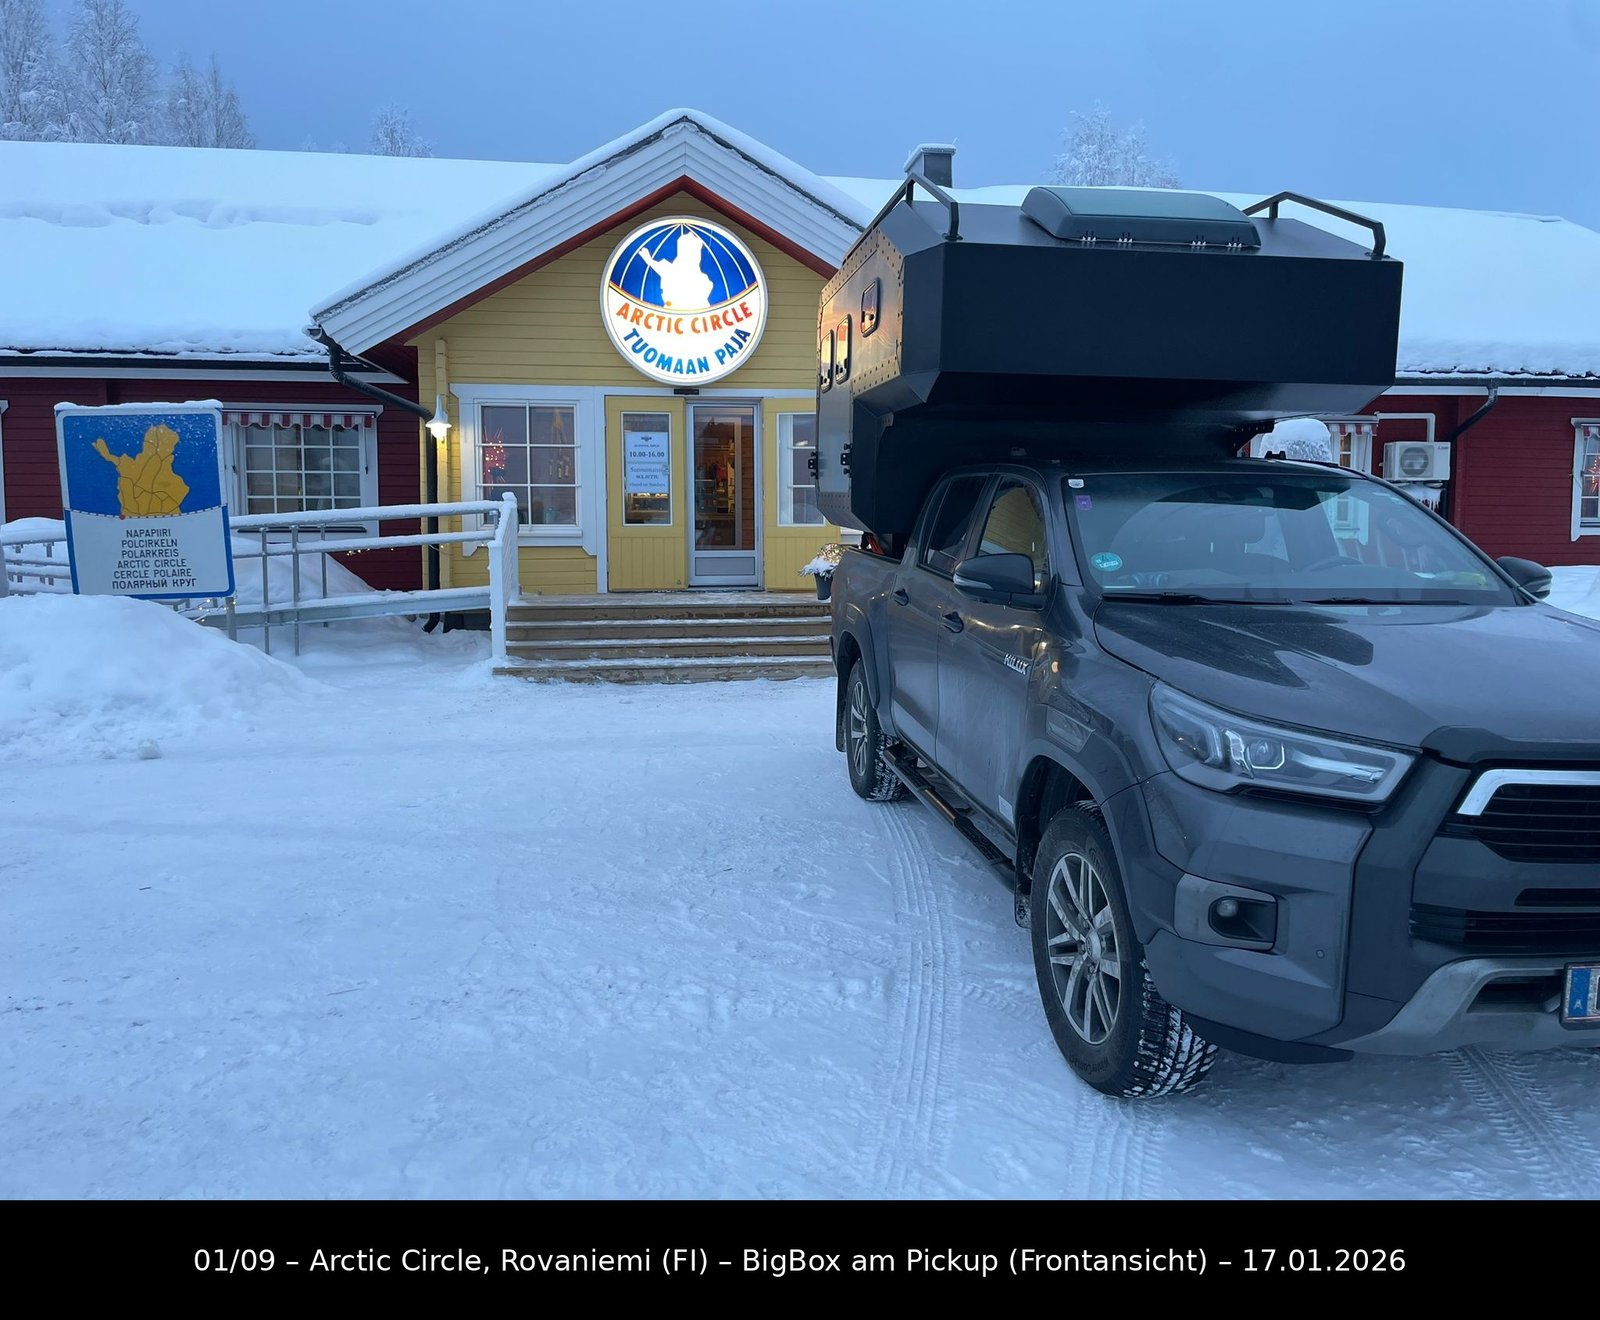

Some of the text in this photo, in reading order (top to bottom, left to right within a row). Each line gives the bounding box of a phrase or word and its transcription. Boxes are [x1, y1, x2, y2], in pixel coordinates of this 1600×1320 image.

[616, 301, 753, 335] ARCTIC CIRCLE
[623, 328, 751, 375] TUOMAAN PAJA
[126, 528, 171, 538] NAPAPIIRI
[121, 539, 178, 548] POLCIRKELN
[121, 549, 179, 558] POLARKREIS
[117, 558, 187, 569] ARCTIC CIRCLE
[113, 568, 192, 579] CERCLE POLAIRE
[112, 578, 196, 589] ПОЛЯРНЫЙ КРУГ
[1574, 999, 1583, 1010] A
